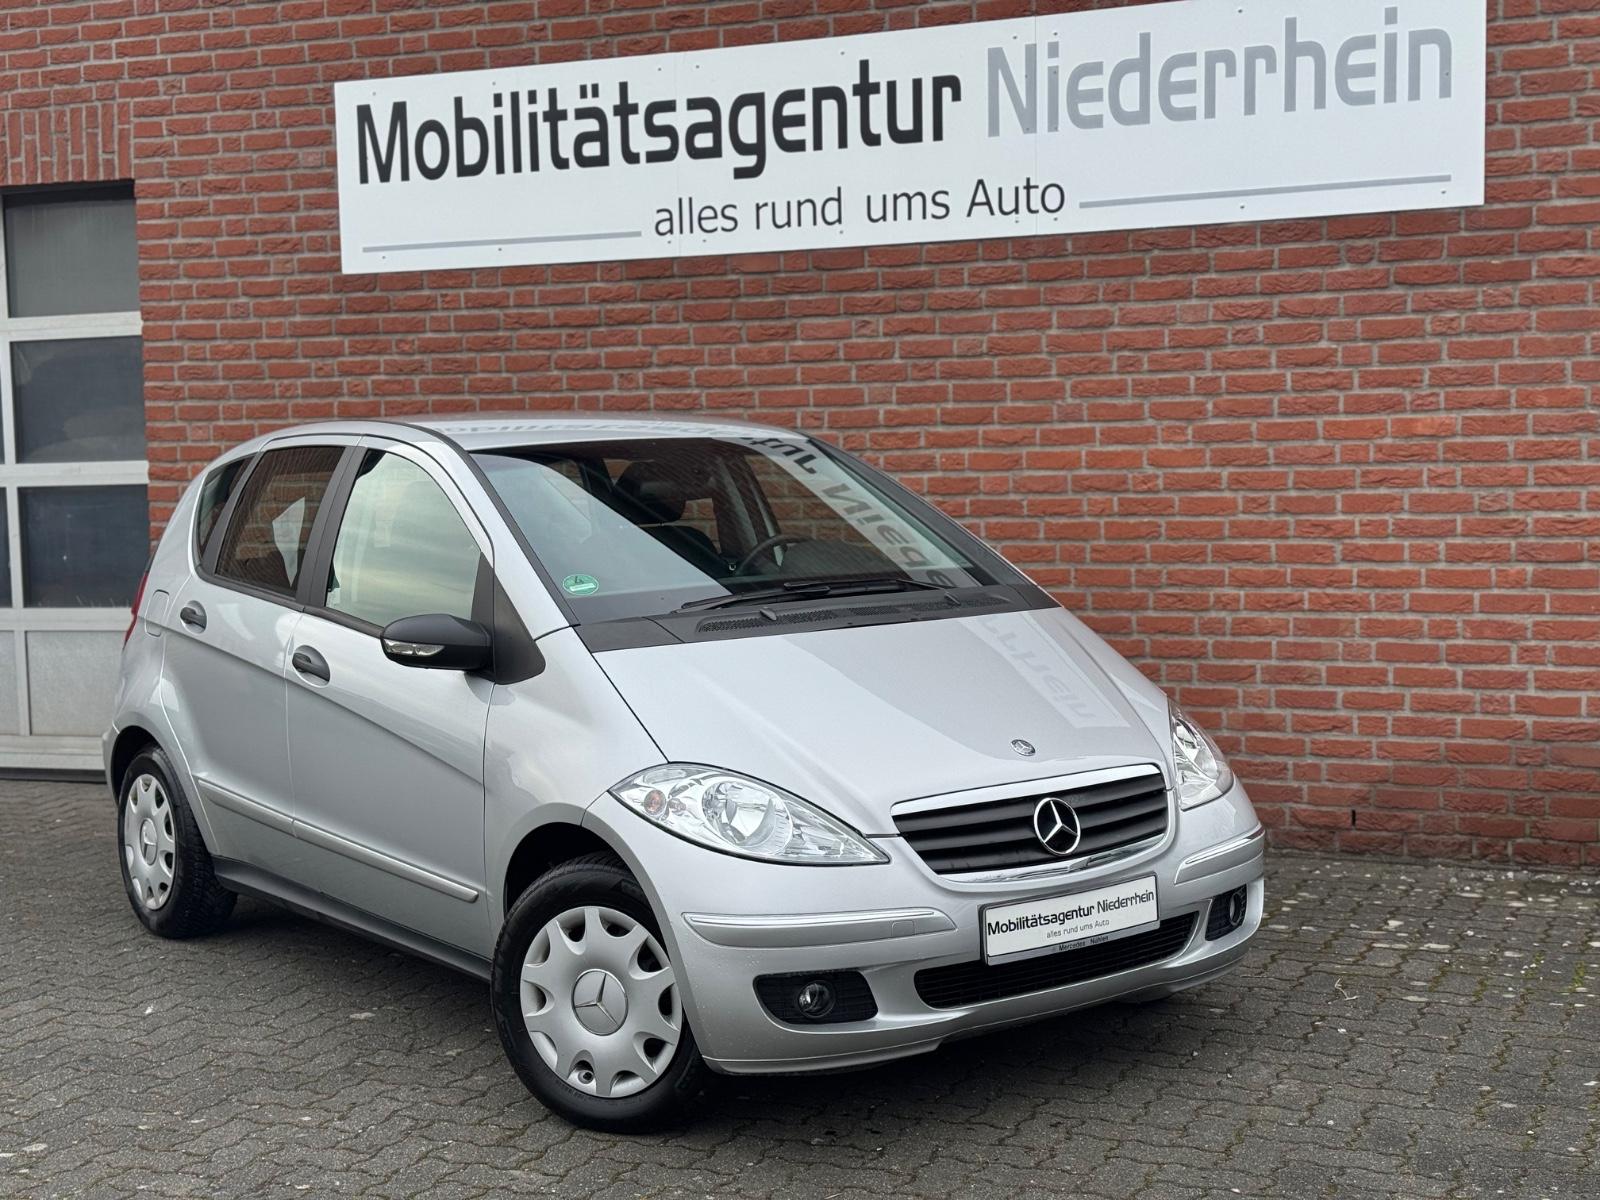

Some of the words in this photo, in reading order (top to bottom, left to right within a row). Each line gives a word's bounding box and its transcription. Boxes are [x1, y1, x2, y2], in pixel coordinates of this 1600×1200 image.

[356, 59, 962, 184] Mobilitätsagentur
[987, 6, 1452, 138] Niederrhein
[654, 197, 739, 236] alles
[755, 186, 843, 230] rund
[866, 187, 951, 223] ums
[966, 176, 1066, 217] Auto
[988, 905, 1095, 936] Mobilitätsagentur
[1097, 889, 1154, 914] Niederrhein
[1046, 930, 1062, 939] alles
[1063, 925, 1079, 934] rund
[1080, 922, 1094, 931] ums
[1095, 919, 1110, 928] Auto
